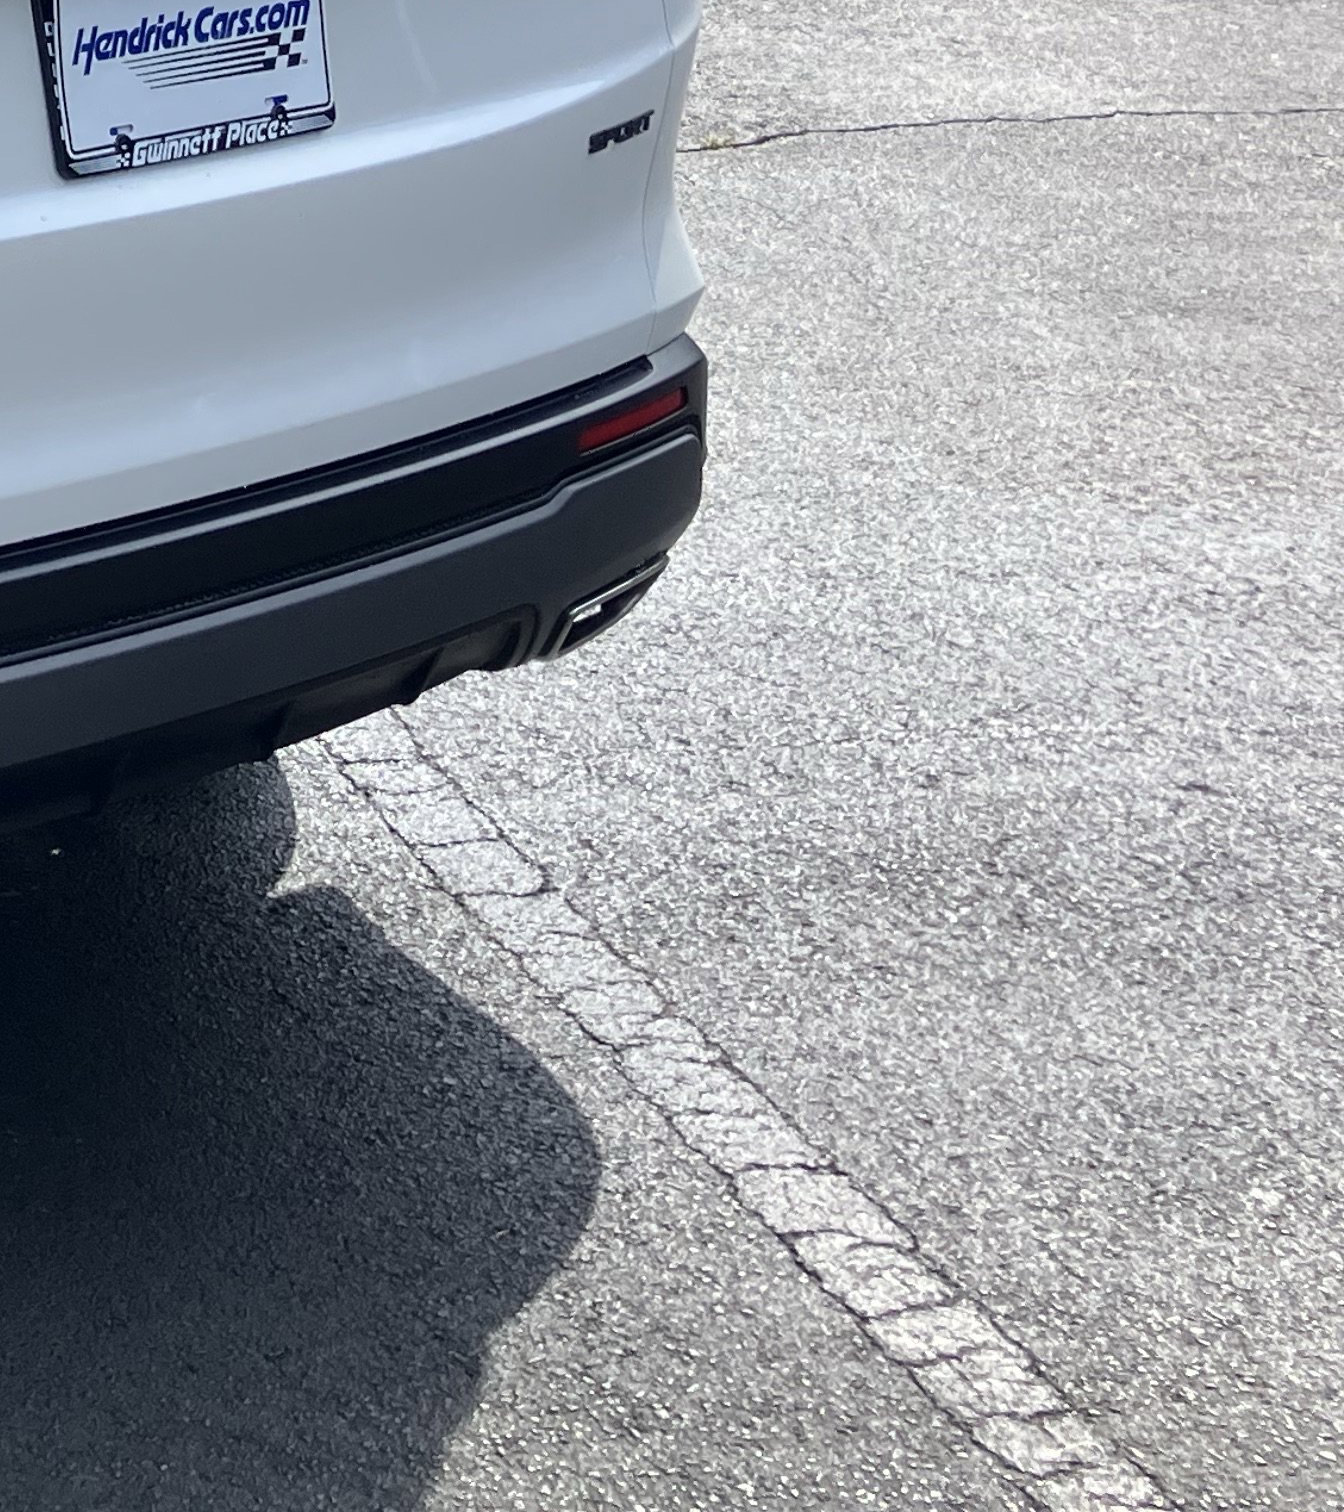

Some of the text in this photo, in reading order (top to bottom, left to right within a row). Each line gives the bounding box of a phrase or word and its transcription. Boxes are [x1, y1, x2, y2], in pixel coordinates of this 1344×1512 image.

[72, 0, 310, 76] Hendrick Cars.com
[132, 115, 279, 167] Gwinnett Place
